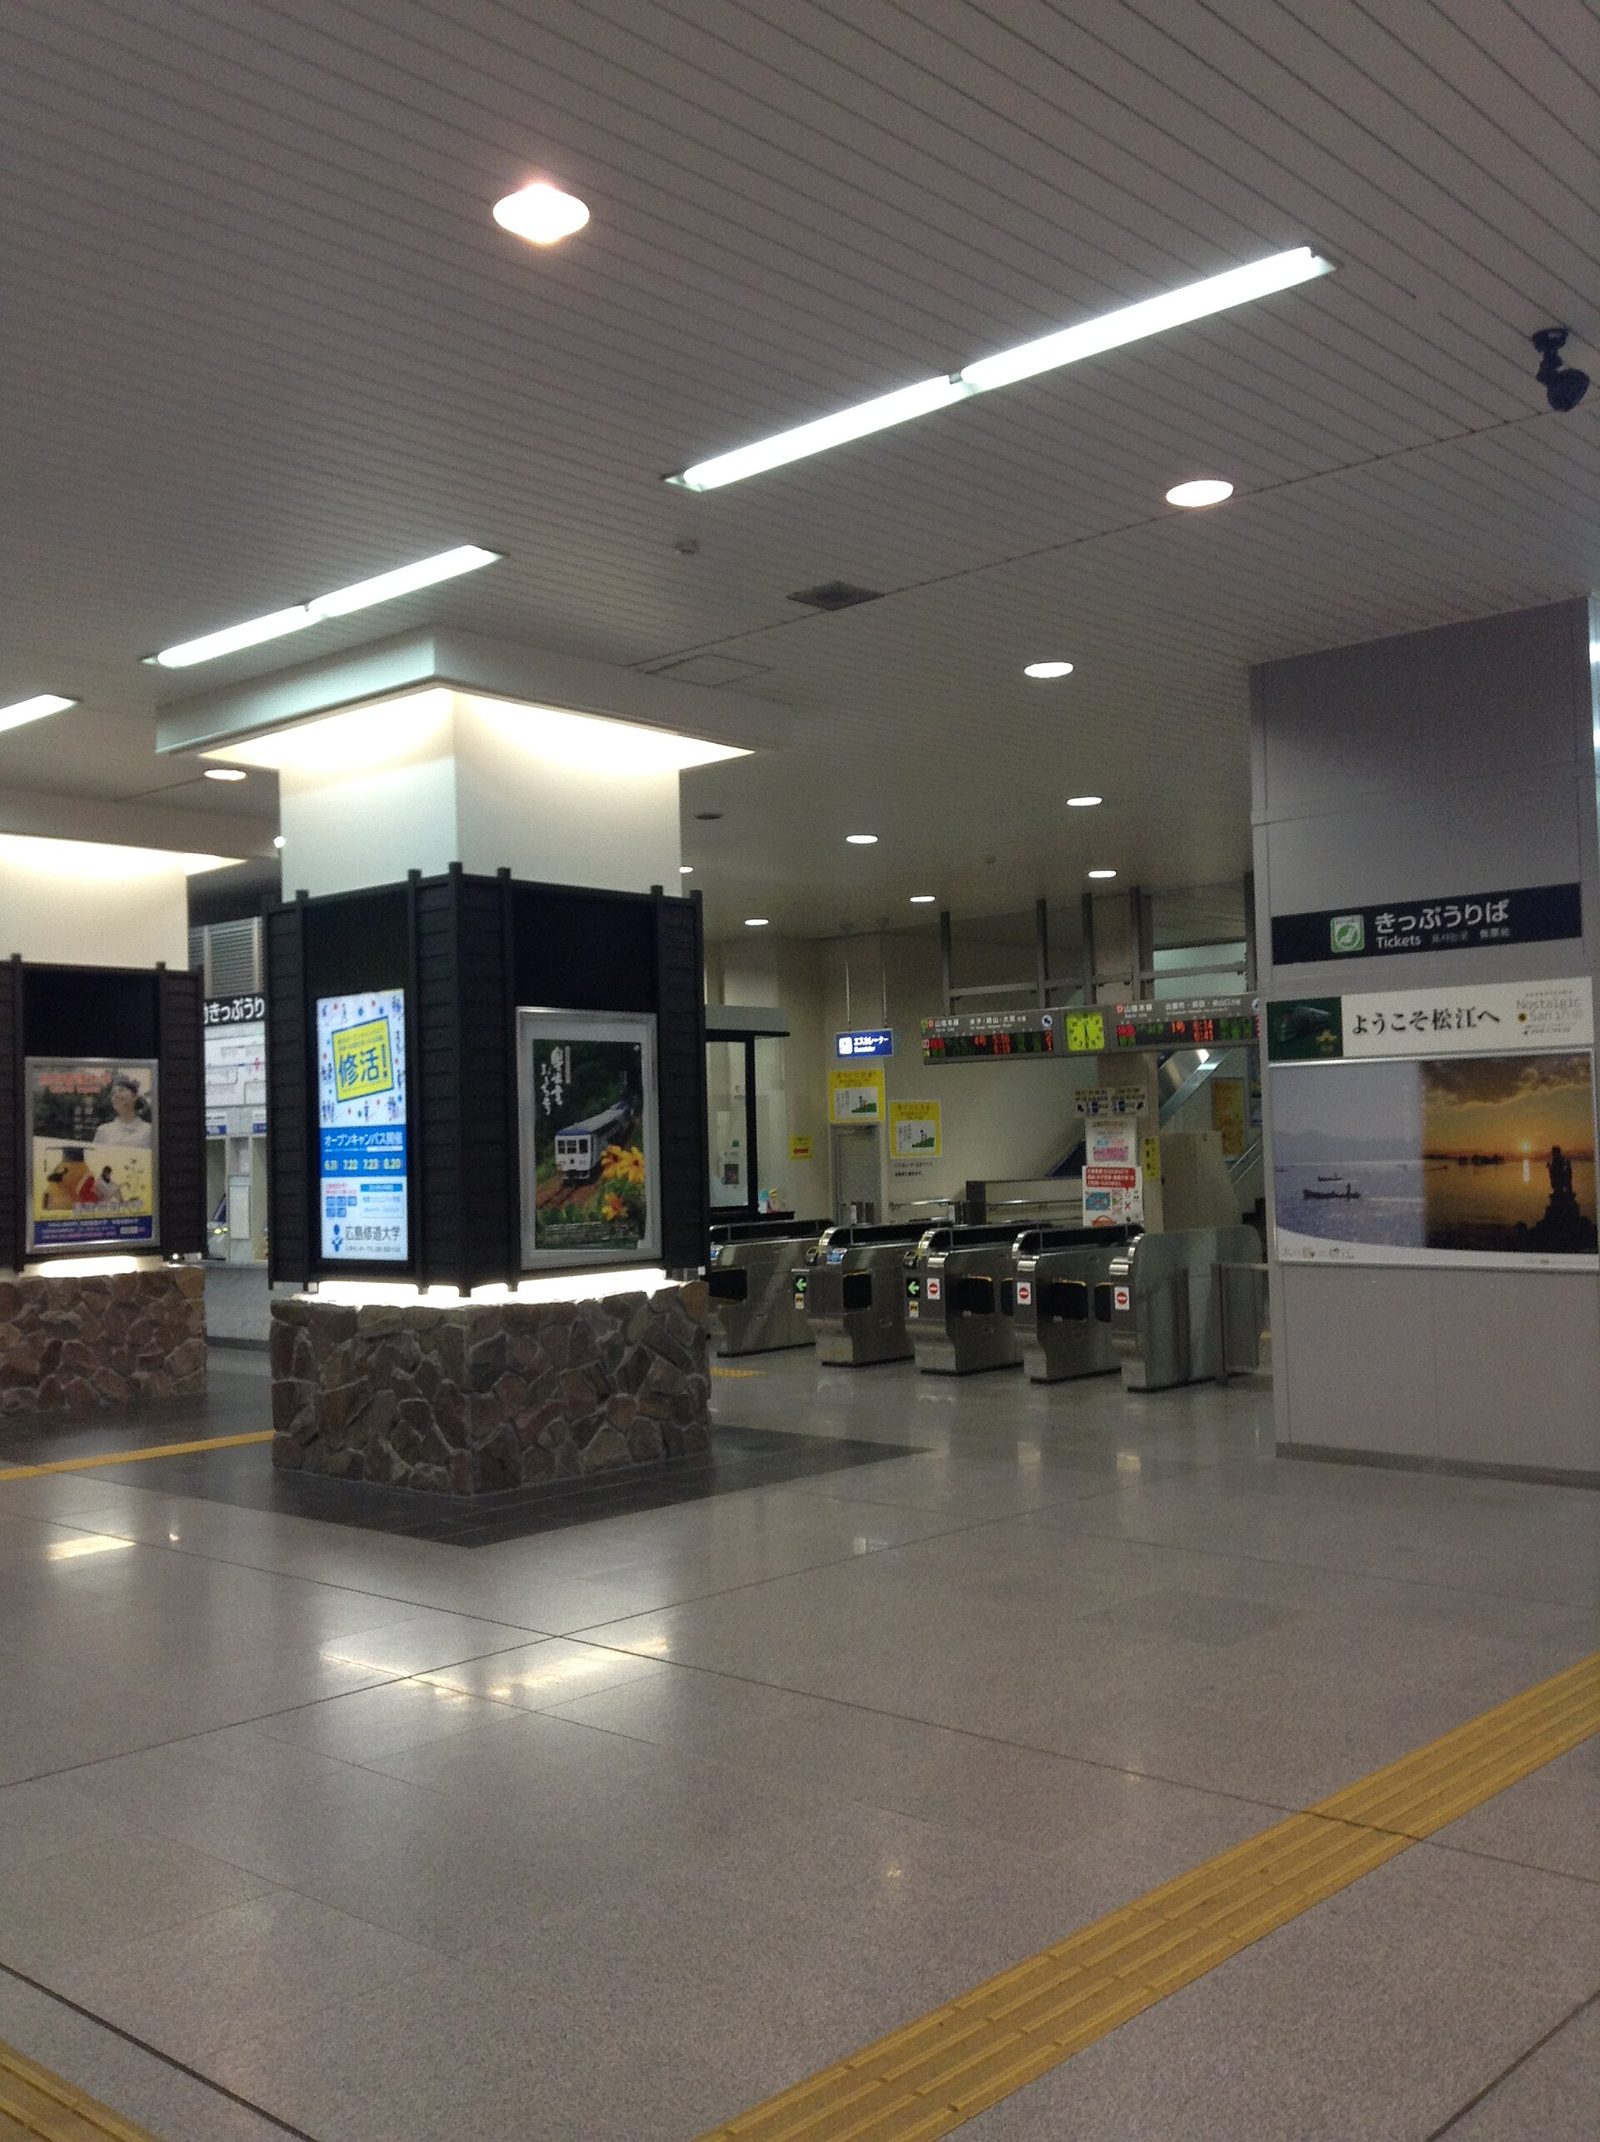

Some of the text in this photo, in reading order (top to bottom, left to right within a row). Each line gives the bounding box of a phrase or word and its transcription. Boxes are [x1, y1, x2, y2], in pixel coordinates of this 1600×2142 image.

[1375, 899, 1510, 934] きっぷうりば
[1376, 935, 1422, 949] Tickets
[1352, 1006, 1500, 1036] ようこそ松江へ
[345, 1225, 401, 1242] 広島修道大学
